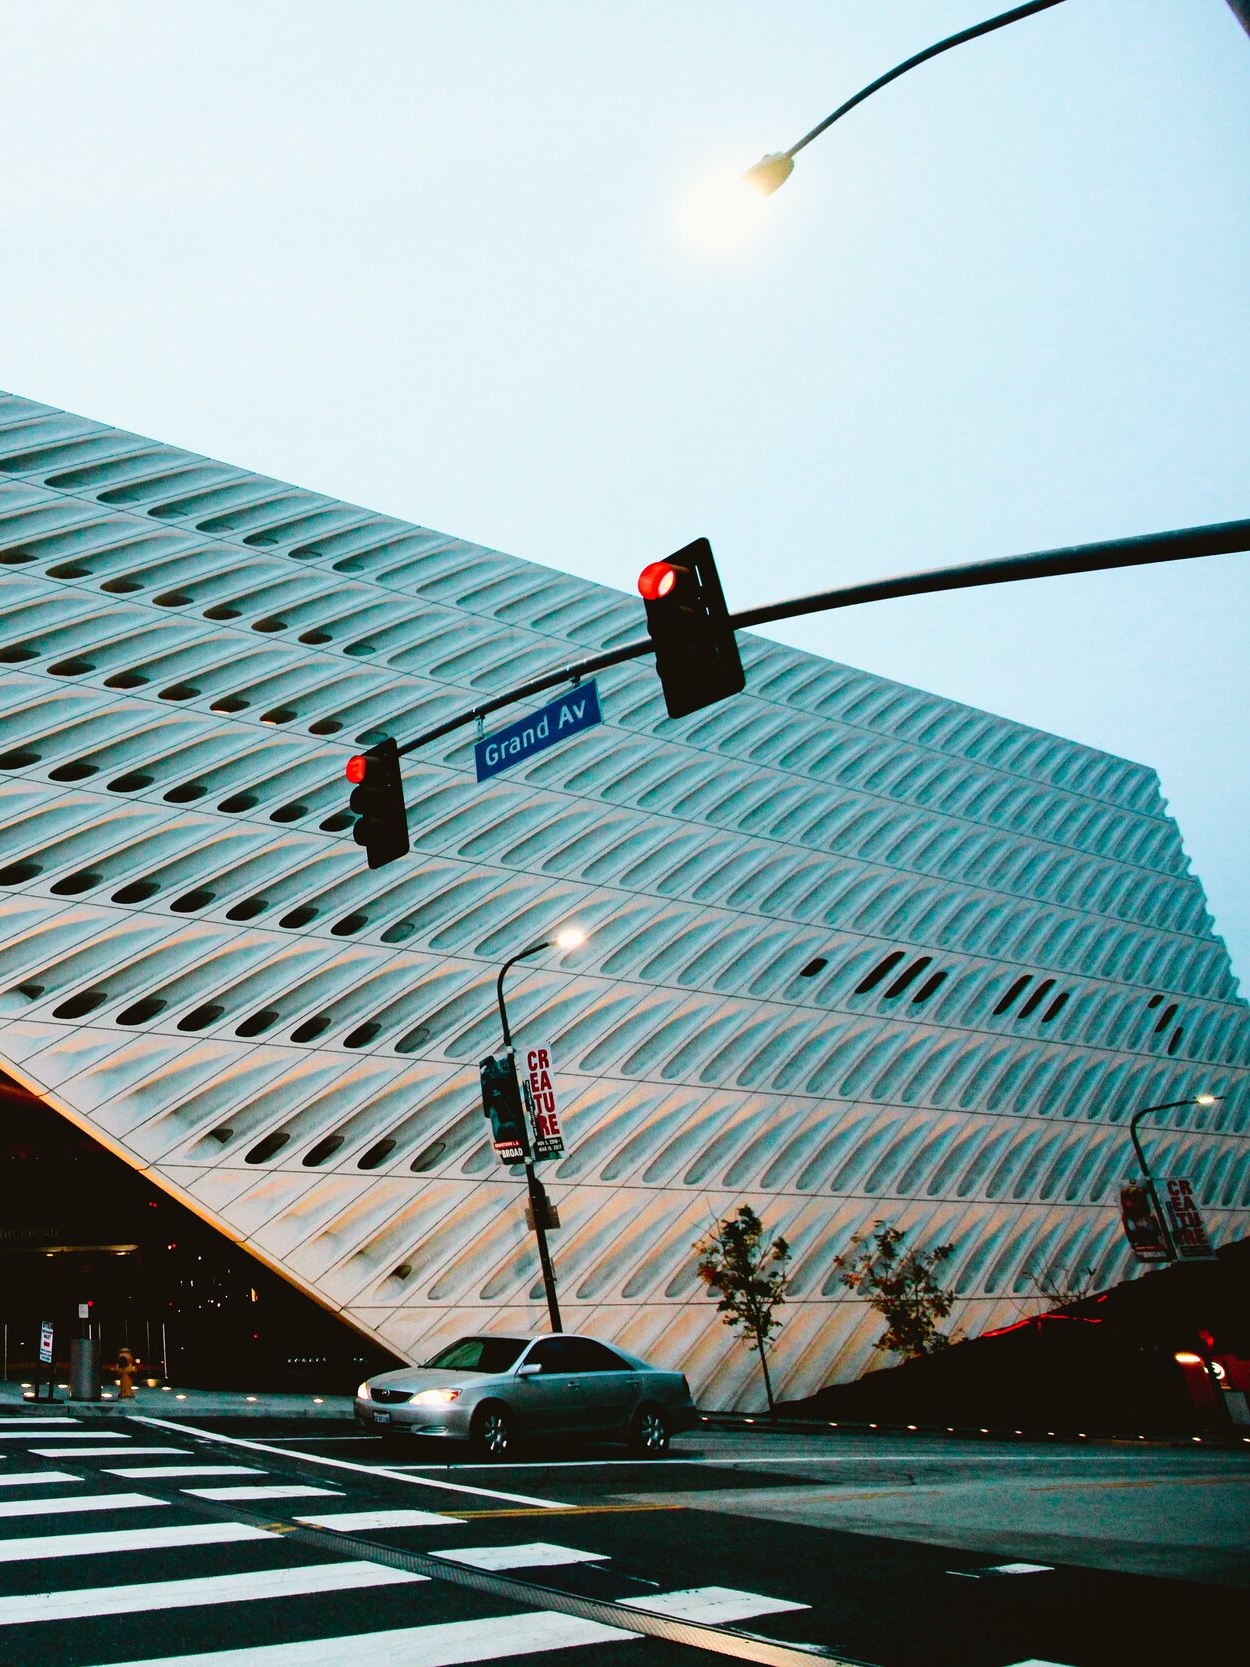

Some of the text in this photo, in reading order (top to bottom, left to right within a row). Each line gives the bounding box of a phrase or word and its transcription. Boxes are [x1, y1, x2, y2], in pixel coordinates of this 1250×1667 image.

[485, 699, 586, 767] Grand Av
[502, 1148, 523, 1158] BROAD
